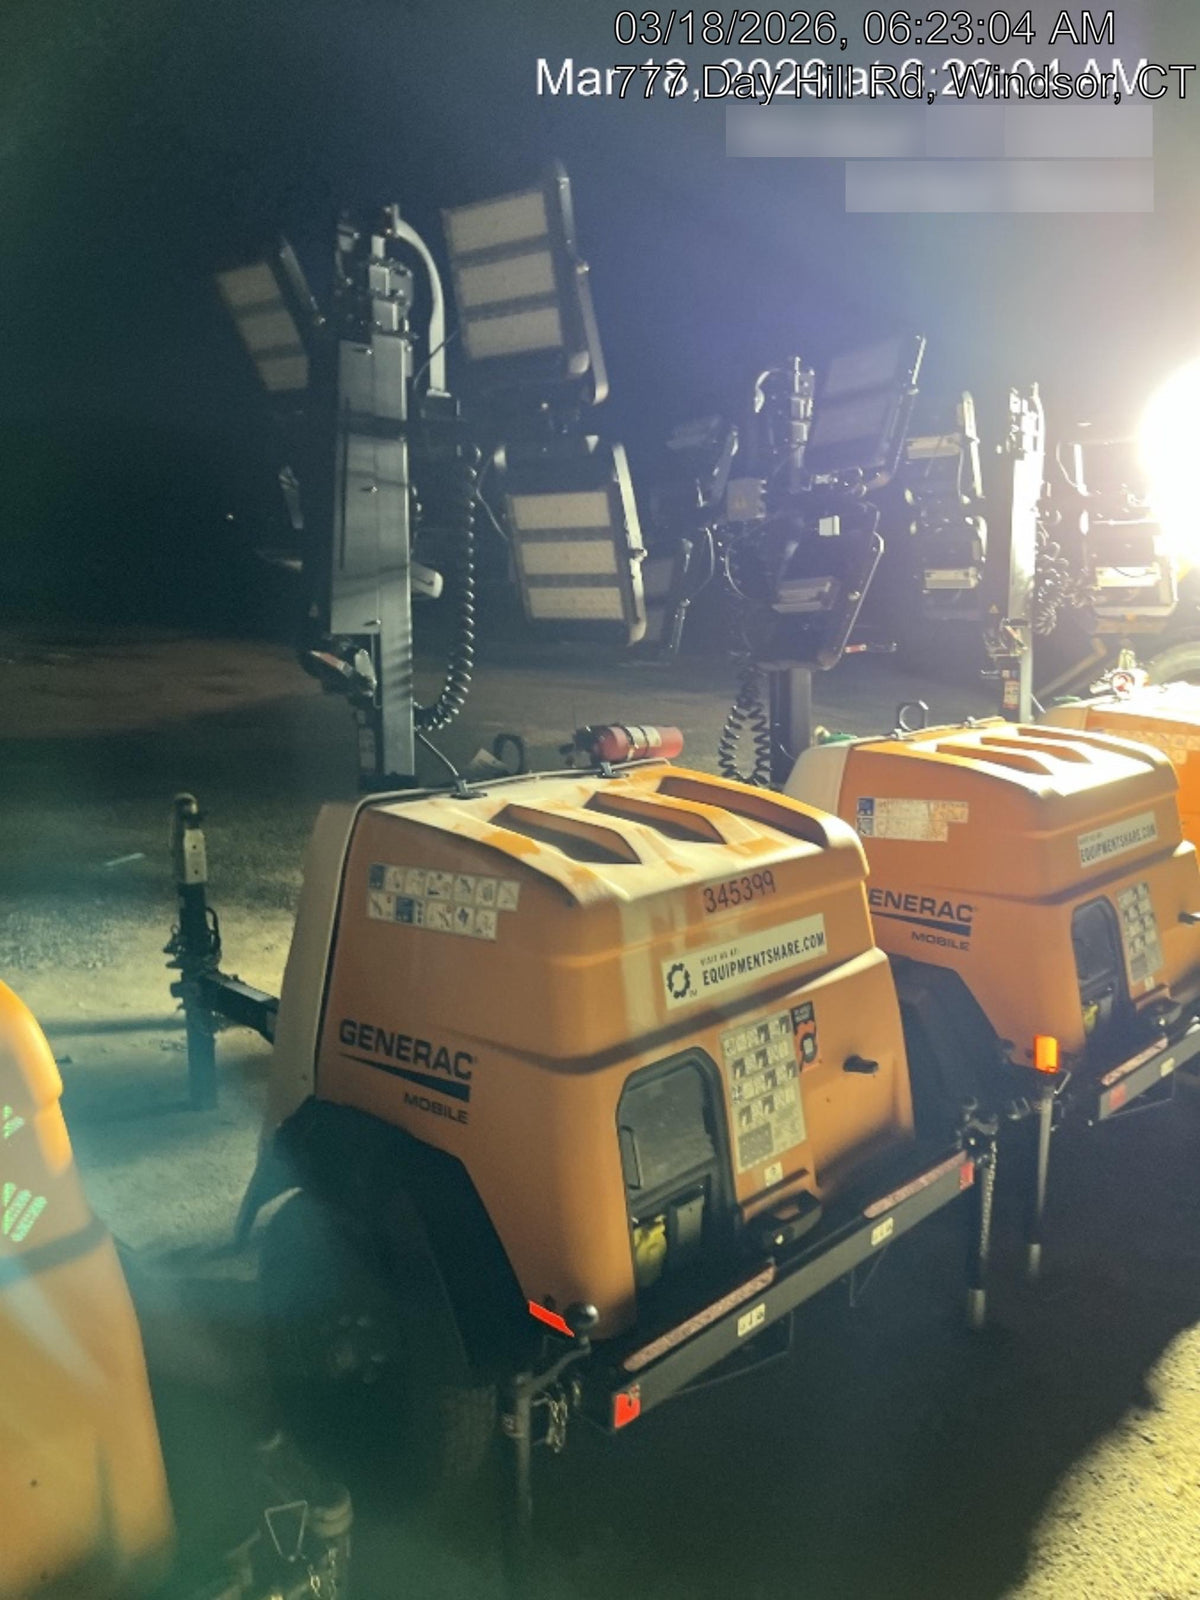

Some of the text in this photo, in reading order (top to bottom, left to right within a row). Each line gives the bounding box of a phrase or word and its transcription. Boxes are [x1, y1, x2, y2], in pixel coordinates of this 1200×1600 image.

[703, 870, 776, 914] 345399
[869, 888, 974, 923] ENERAC
[702, 932, 825, 986] EQUIPMENTSHARE.COM
[911, 931, 970, 951] MOBILE
[339, 1018, 473, 1080] GENERAC
[404, 1092, 469, 1125] MOBILE
